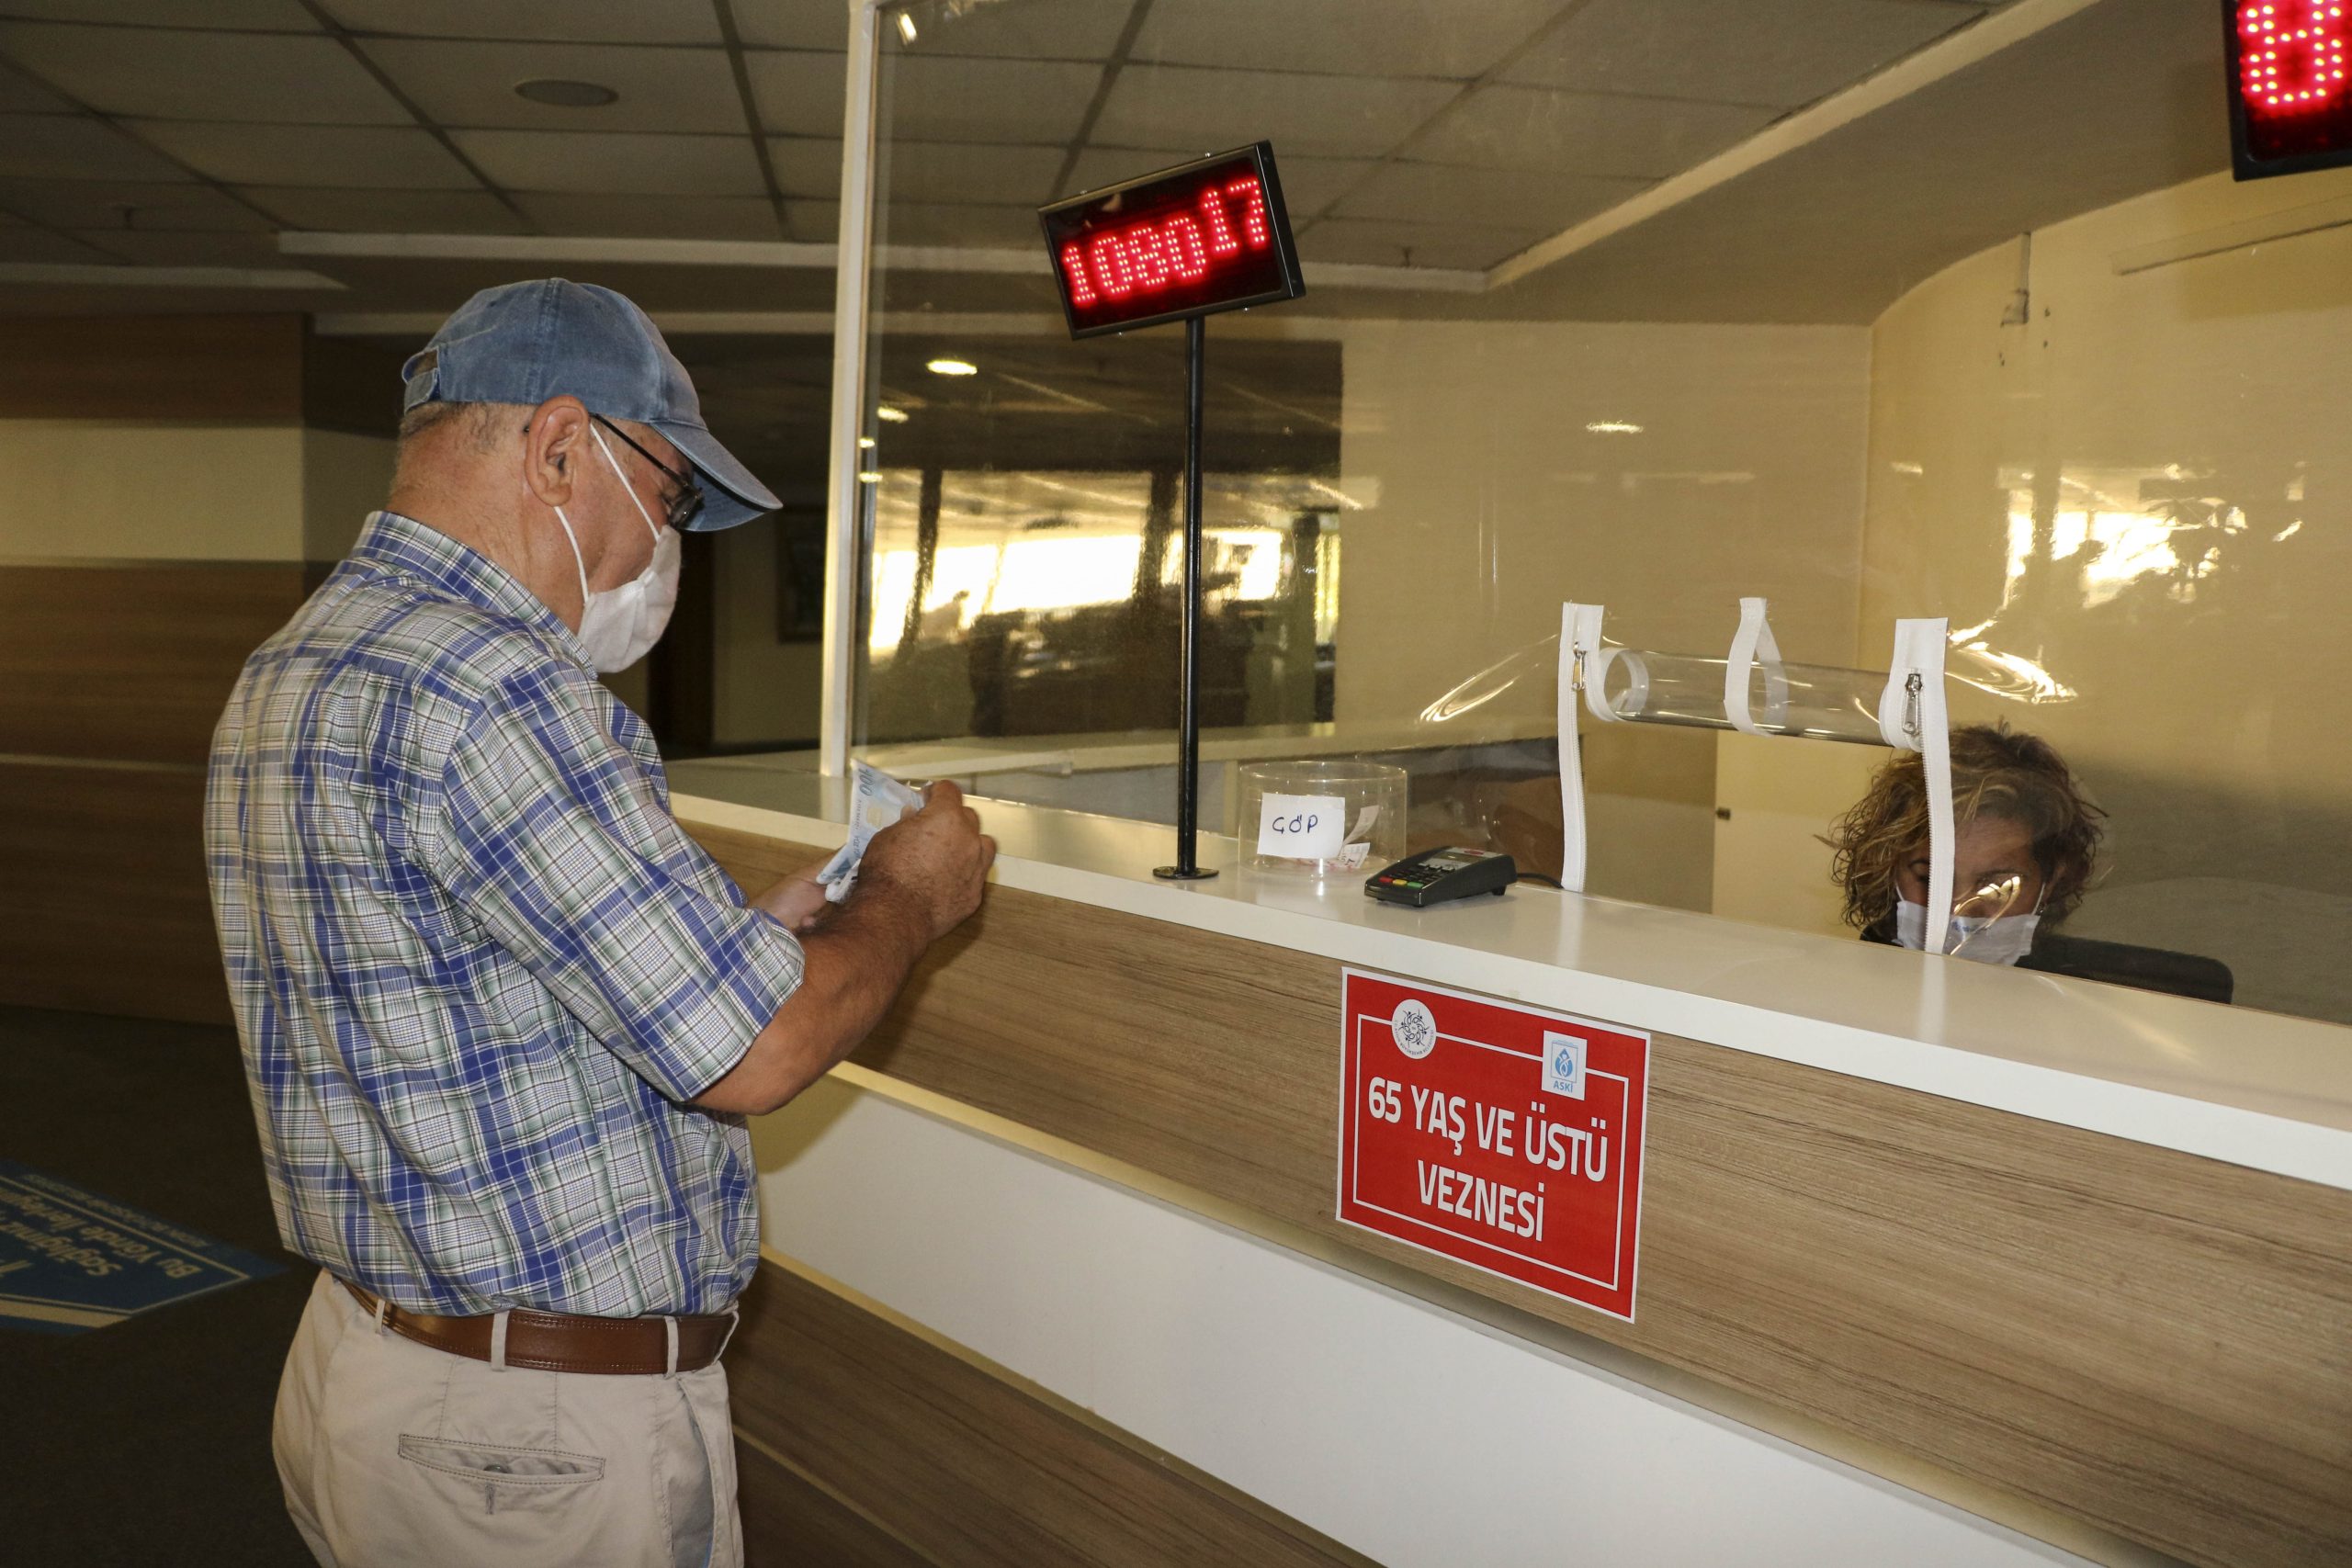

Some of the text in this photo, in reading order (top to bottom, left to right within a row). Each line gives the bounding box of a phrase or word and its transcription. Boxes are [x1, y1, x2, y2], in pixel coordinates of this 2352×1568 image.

[1064, 179, 1267, 302] 1080 17
[1368, 1077, 1609, 1183] 65 YAŞ VE ÜSTÜ
[1553, 1079, 1574, 1093] ASKİ
[1418, 1159, 1544, 1241] VEZNESİ
